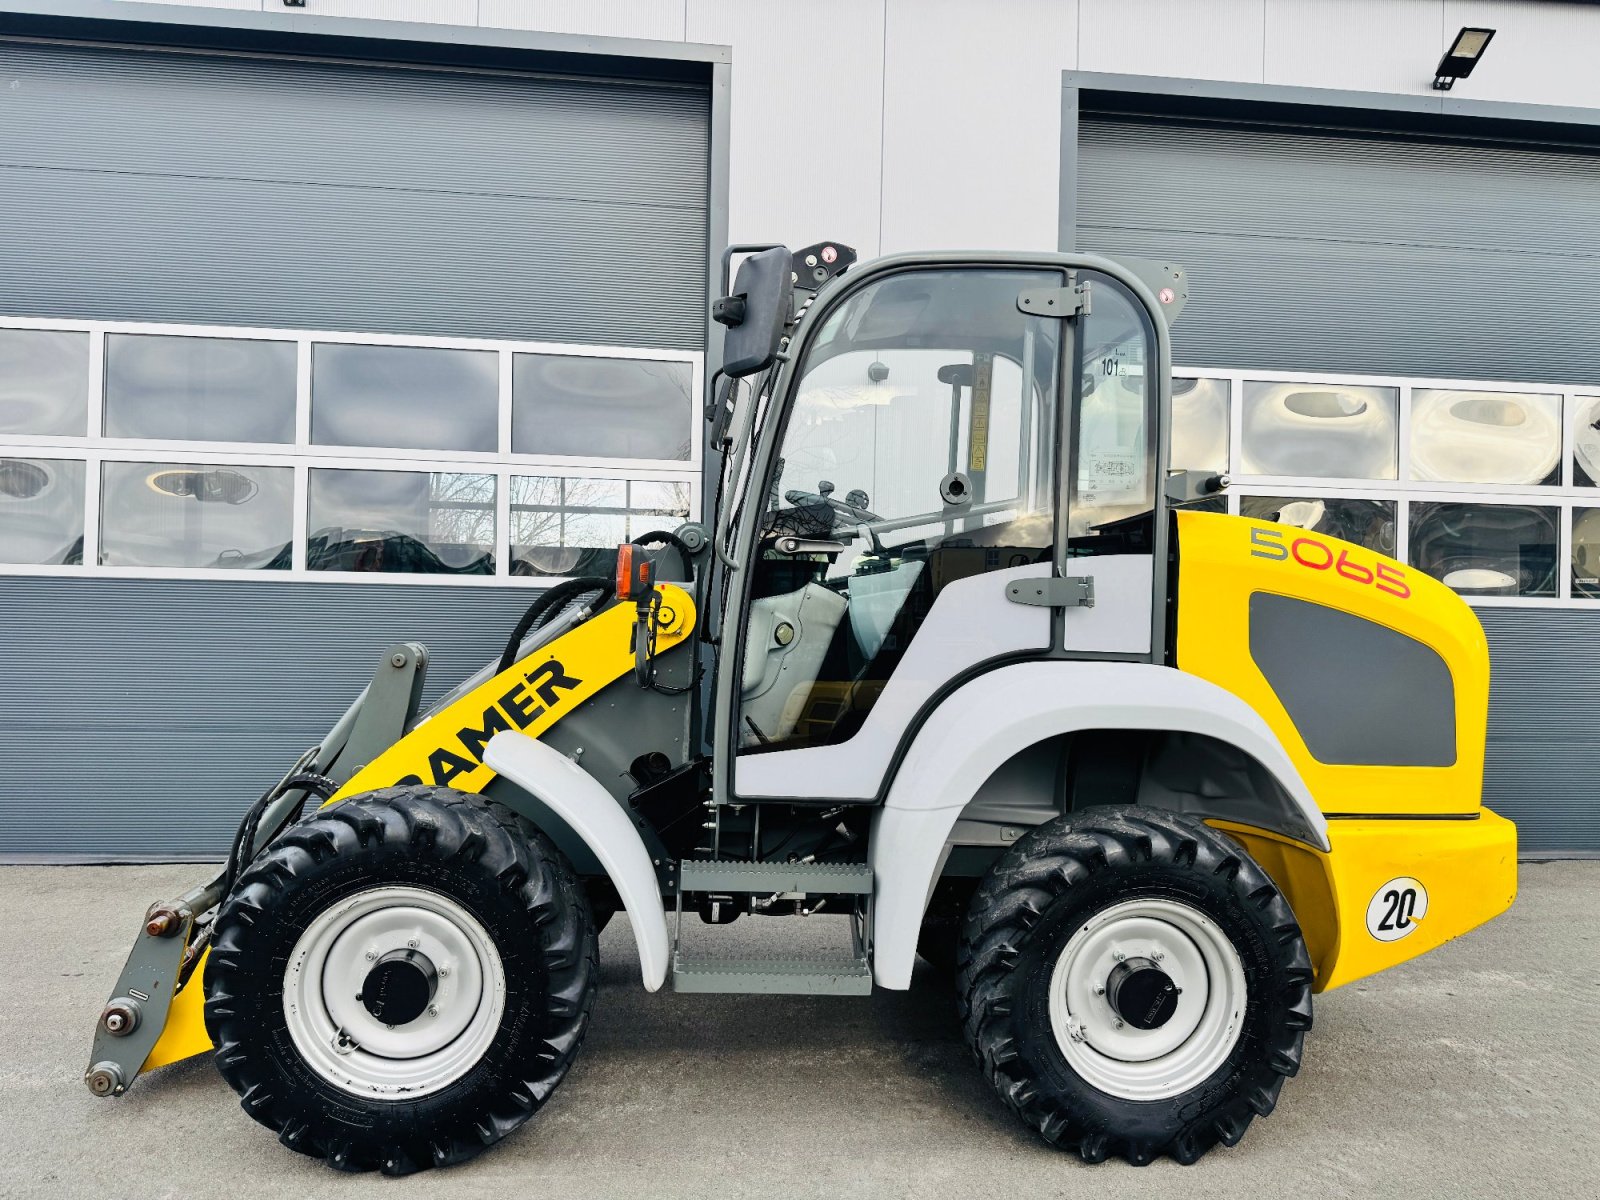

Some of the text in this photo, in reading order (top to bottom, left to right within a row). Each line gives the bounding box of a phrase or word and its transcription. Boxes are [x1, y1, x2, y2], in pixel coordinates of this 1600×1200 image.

[1101, 358, 1119, 377] 101
[1250, 526, 1412, 600] 5065
[1377, 888, 1417, 932] 20
